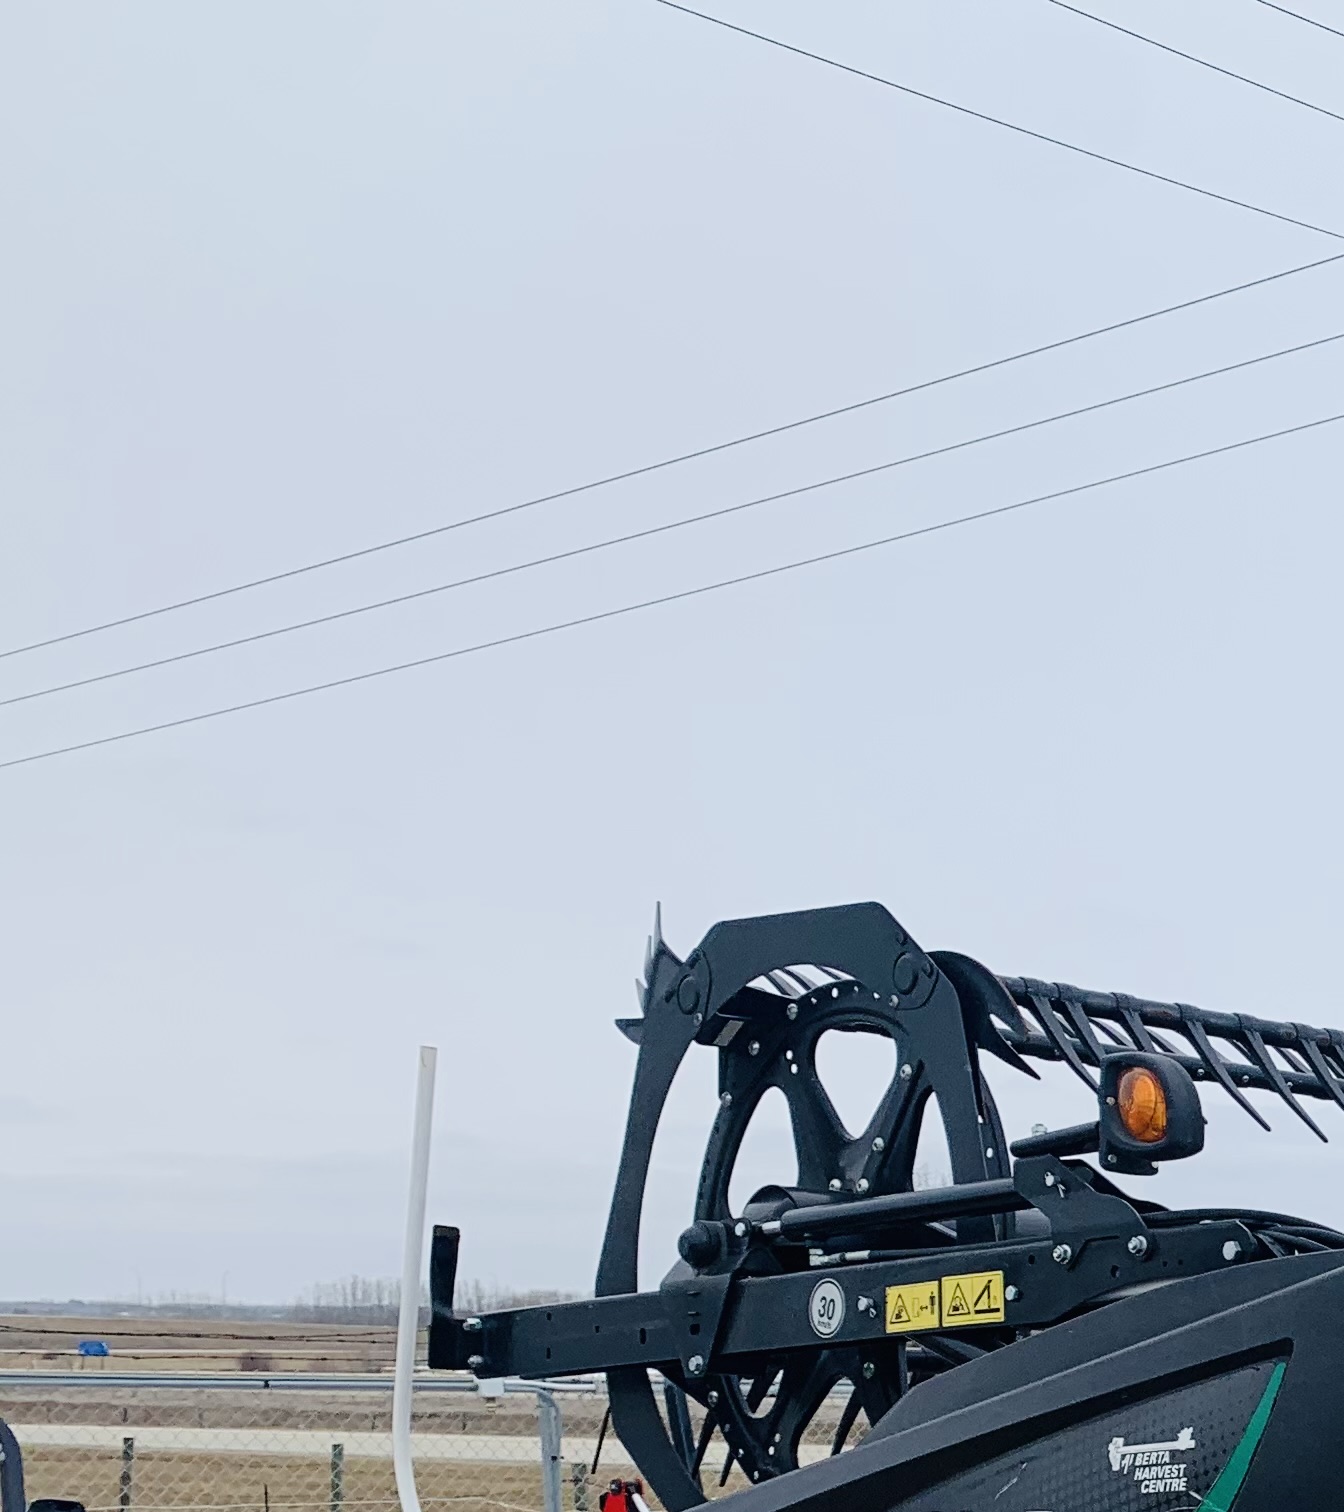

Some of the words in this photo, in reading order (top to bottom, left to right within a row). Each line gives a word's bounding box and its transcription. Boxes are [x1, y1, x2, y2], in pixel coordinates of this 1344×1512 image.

[818, 1295, 836, 1321] 30
[1134, 1463, 1187, 1481] HARVEST
[1140, 1477, 1188, 1494] CENTRE
